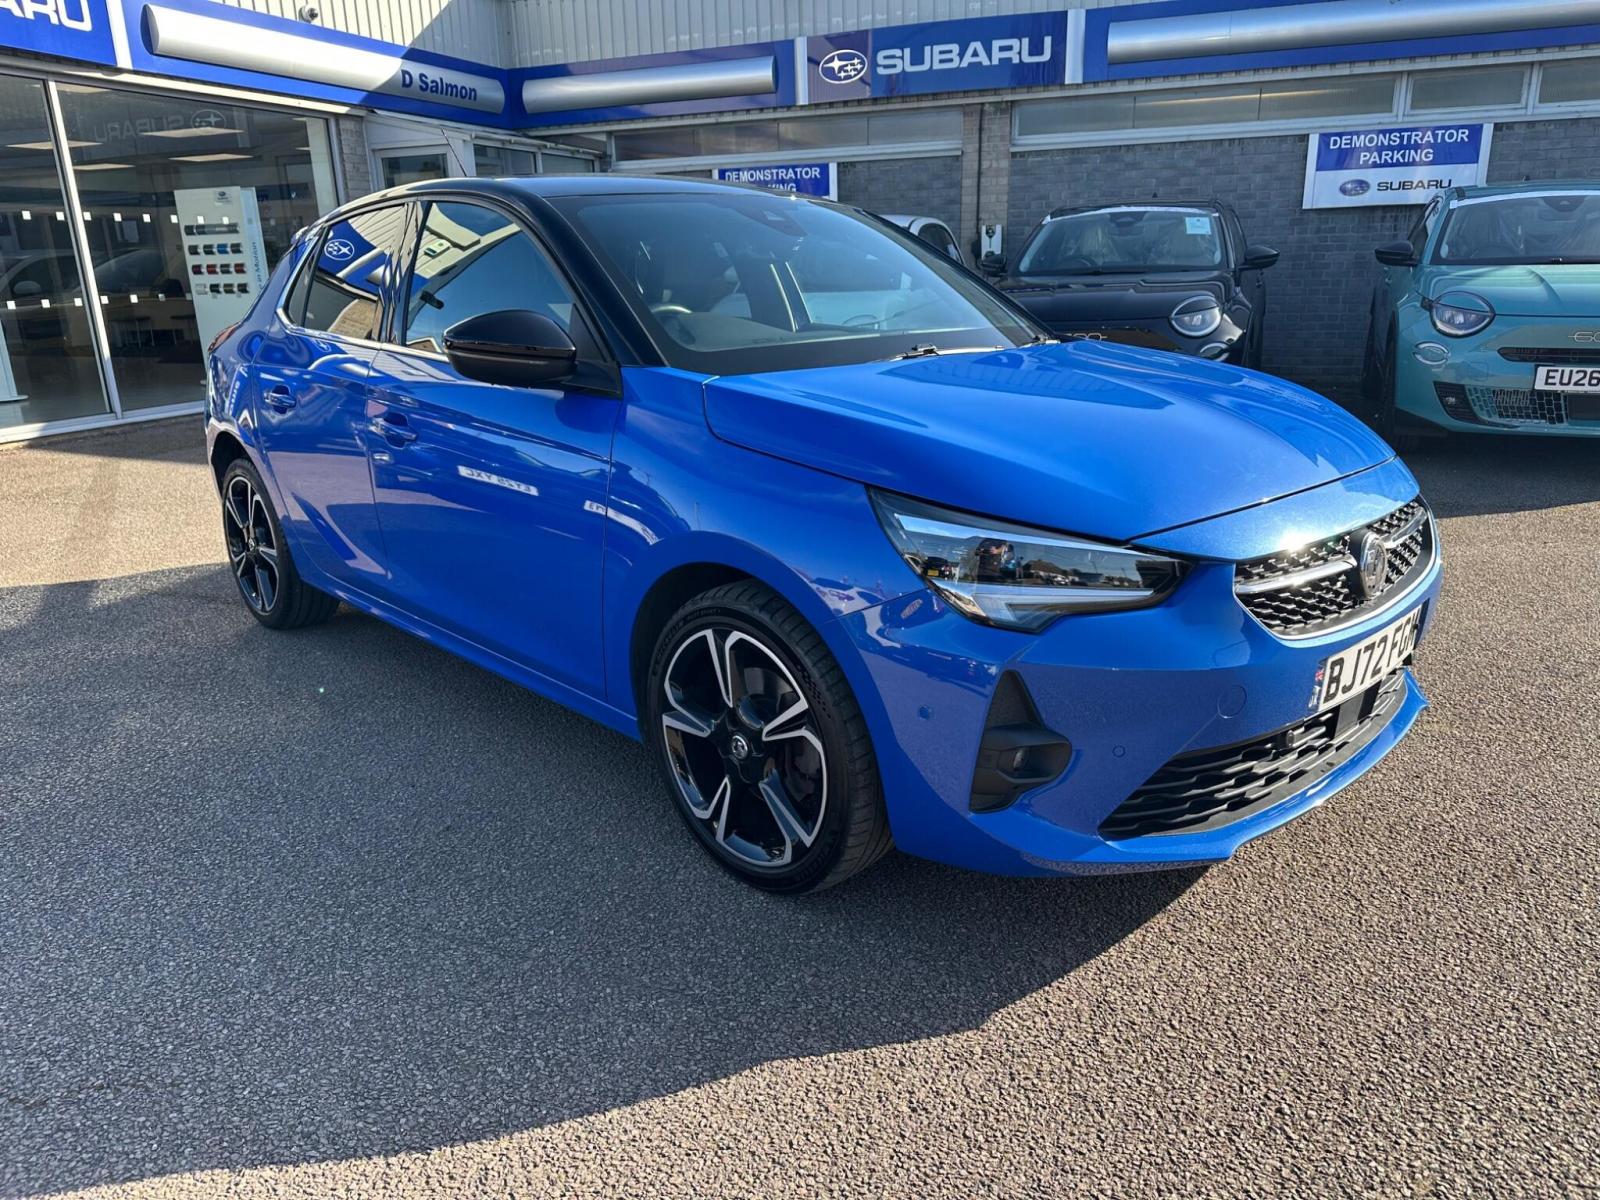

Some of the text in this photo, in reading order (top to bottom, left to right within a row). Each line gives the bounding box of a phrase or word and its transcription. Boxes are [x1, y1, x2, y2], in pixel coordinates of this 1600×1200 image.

[876, 36, 1052, 75] SUBARU
[401, 69, 477, 101] D Salmon
[1329, 129, 1469, 149] DEMONSTRATOR
[1359, 149, 1434, 165] PARKING
[725, 167, 821, 182] DEMONSTRATOR
[1377, 179, 1452, 192] SUBARU
[1544, 369, 1600, 387] EU26
[1323, 634, 1389, 704] BJ72
